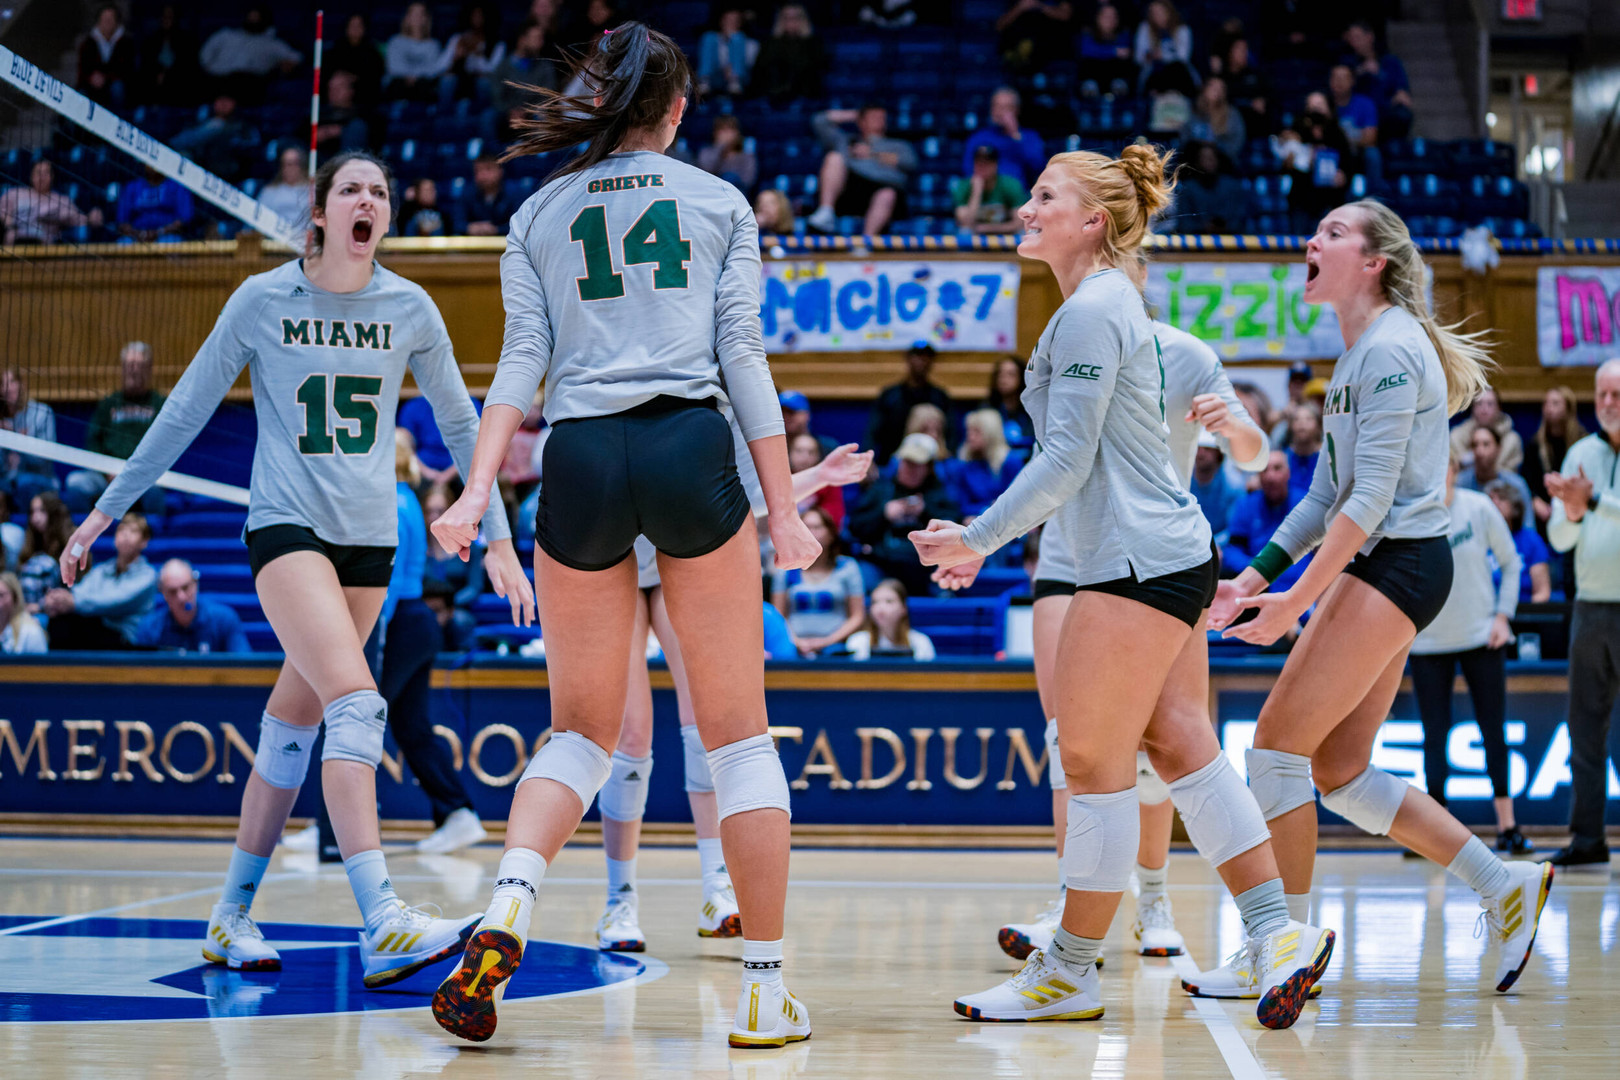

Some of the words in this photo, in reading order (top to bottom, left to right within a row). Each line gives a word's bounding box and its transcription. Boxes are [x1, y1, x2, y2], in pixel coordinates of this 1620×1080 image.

[11, 53, 35, 85] BLUE
[587, 173, 665, 194] GRIEVE
[569, 198, 692, 302] 14
[281, 317, 393, 351] MIAMI
[1062, 363, 1103, 380] ACC
[1374, 372, 1408, 393] ACC
[296, 373, 384, 455] 15
[768, 725, 1050, 791] TADIUM
